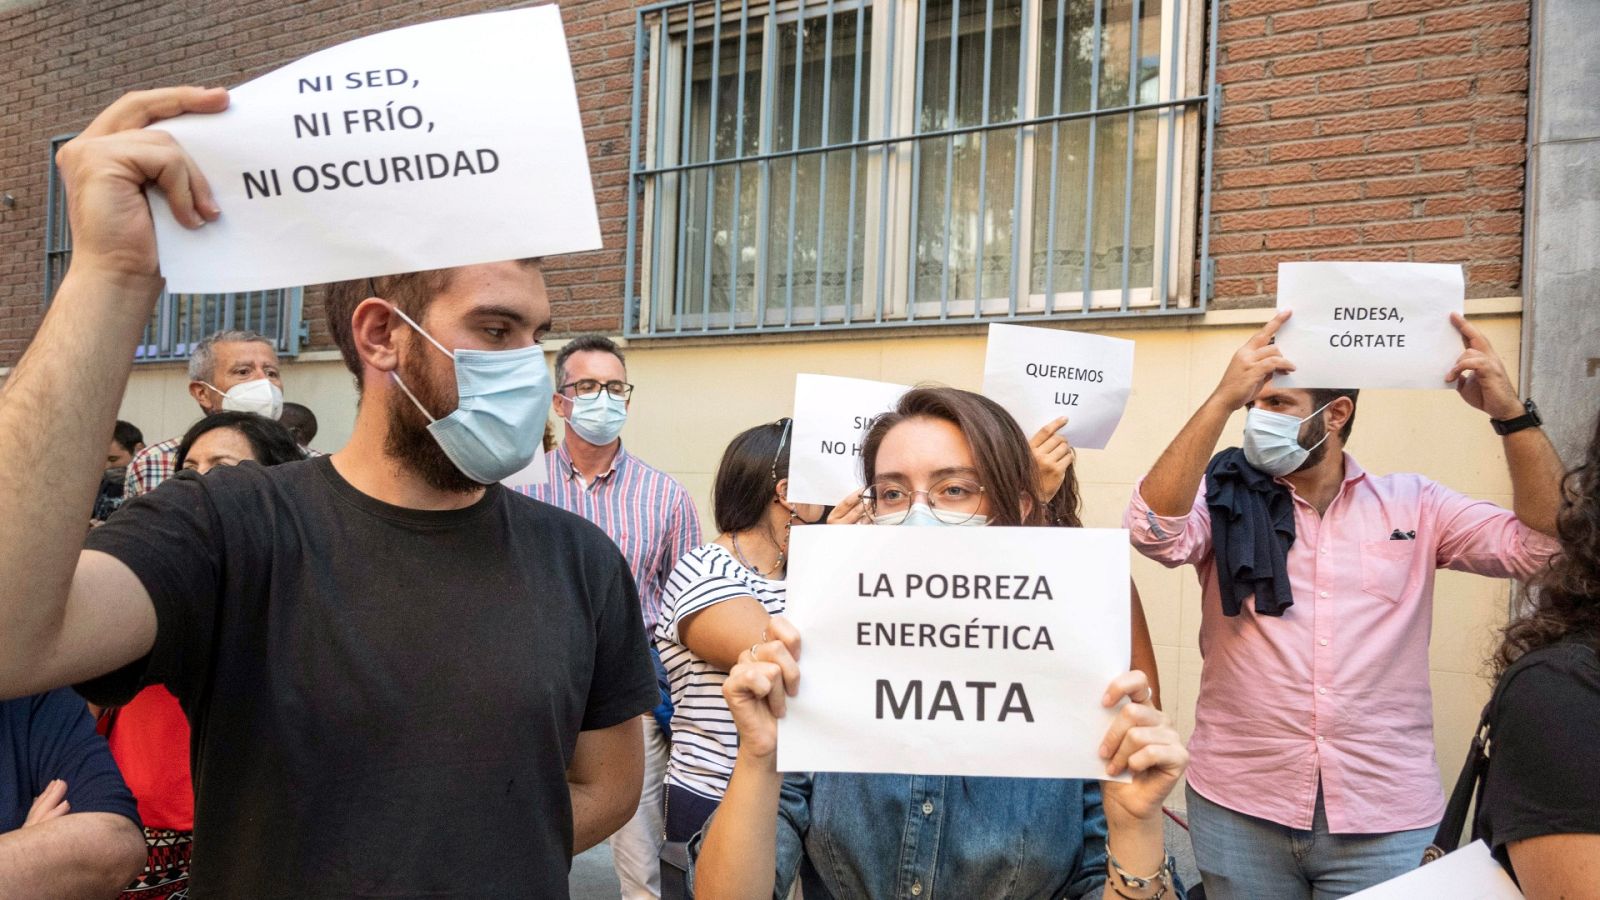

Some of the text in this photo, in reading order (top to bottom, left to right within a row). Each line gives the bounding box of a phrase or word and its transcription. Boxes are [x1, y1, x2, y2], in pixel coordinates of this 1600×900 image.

[299, 68, 419, 94] NI SED,
[294, 101, 435, 139] NI FRÍO,
[242, 148, 499, 200] NI OSCURIDAD
[1333, 307, 1405, 323] ENDESA,
[1329, 329, 1406, 348] CÓRTATE
[1026, 363, 1104, 383] QUEREMOS
[1054, 392, 1079, 407] LUZ
[820, 440, 846, 455] NO
[858, 573, 1054, 601] LA POBREZA
[857, 617, 1055, 651] ENERGÉTICA
[875, 679, 1035, 723] MATA
